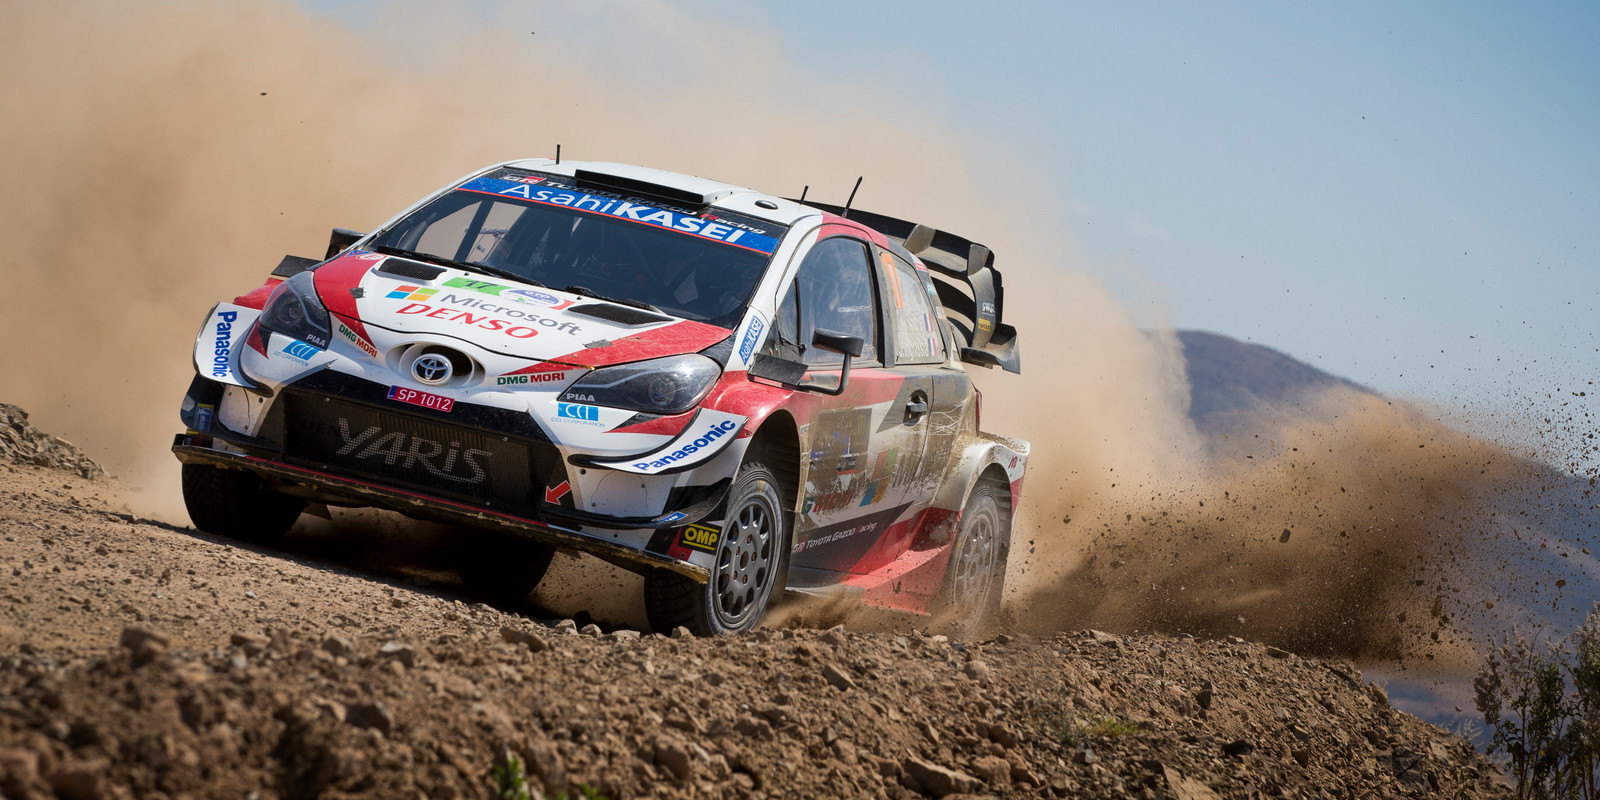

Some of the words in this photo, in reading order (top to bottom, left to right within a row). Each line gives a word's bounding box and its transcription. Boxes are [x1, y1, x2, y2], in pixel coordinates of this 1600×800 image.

[700, 213, 767, 235] Racing
[466, 279, 494, 290] 17
[395, 303, 539, 339] DENSO
[440, 293, 582, 336] Microsoft
[212, 310, 238, 378] Panasonic
[306, 333, 327, 347] PIAA
[338, 324, 356, 342] DMG
[356, 338, 378, 358] MORI
[497, 375, 528, 385] DMG
[530, 372, 565, 383] MORI
[397, 388, 417, 401] SP
[420, 393, 451, 411] 1012
[566, 393, 596, 402] PIAA
[563, 419, 606, 428] CORPORATION
[632, 420, 736, 471] Panasonic
[684, 527, 718, 546] OMP
[806, 534, 832, 549] TOYOTA
[832, 527, 856, 542] GAZOO
